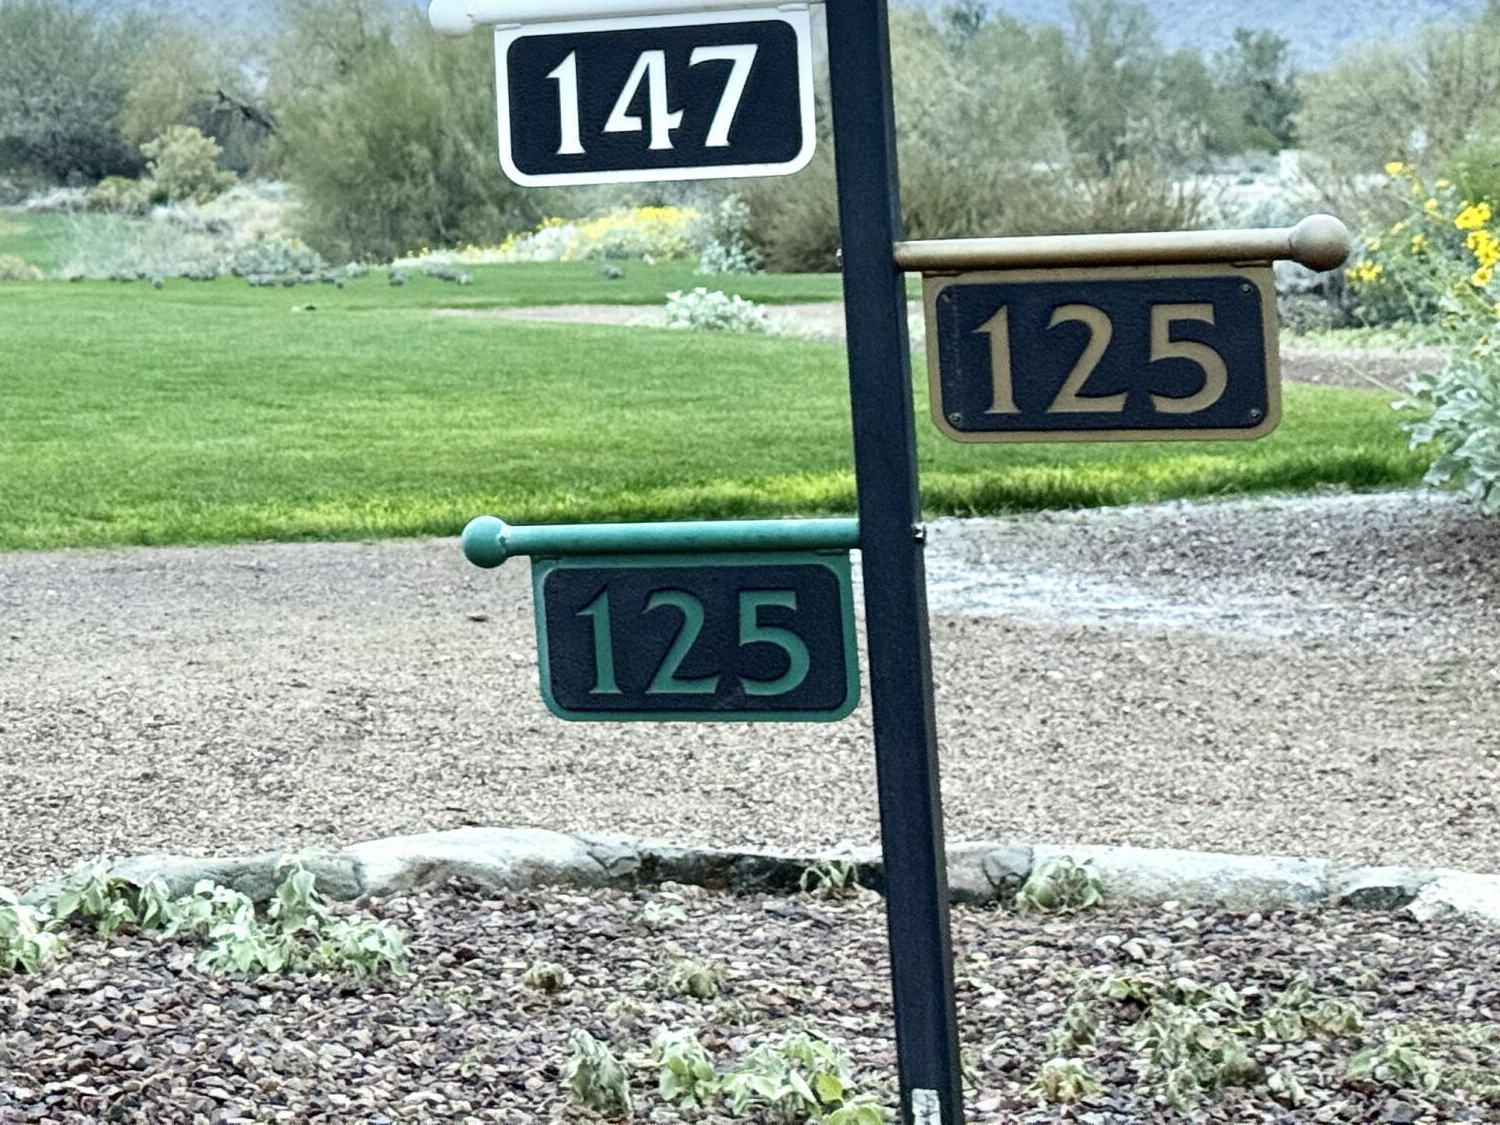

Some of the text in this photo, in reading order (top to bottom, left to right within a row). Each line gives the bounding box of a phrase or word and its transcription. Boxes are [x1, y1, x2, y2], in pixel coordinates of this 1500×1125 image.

[544, 43, 759, 157] 147
[971, 302, 1229, 416] 125
[576, 586, 812, 698] 125
